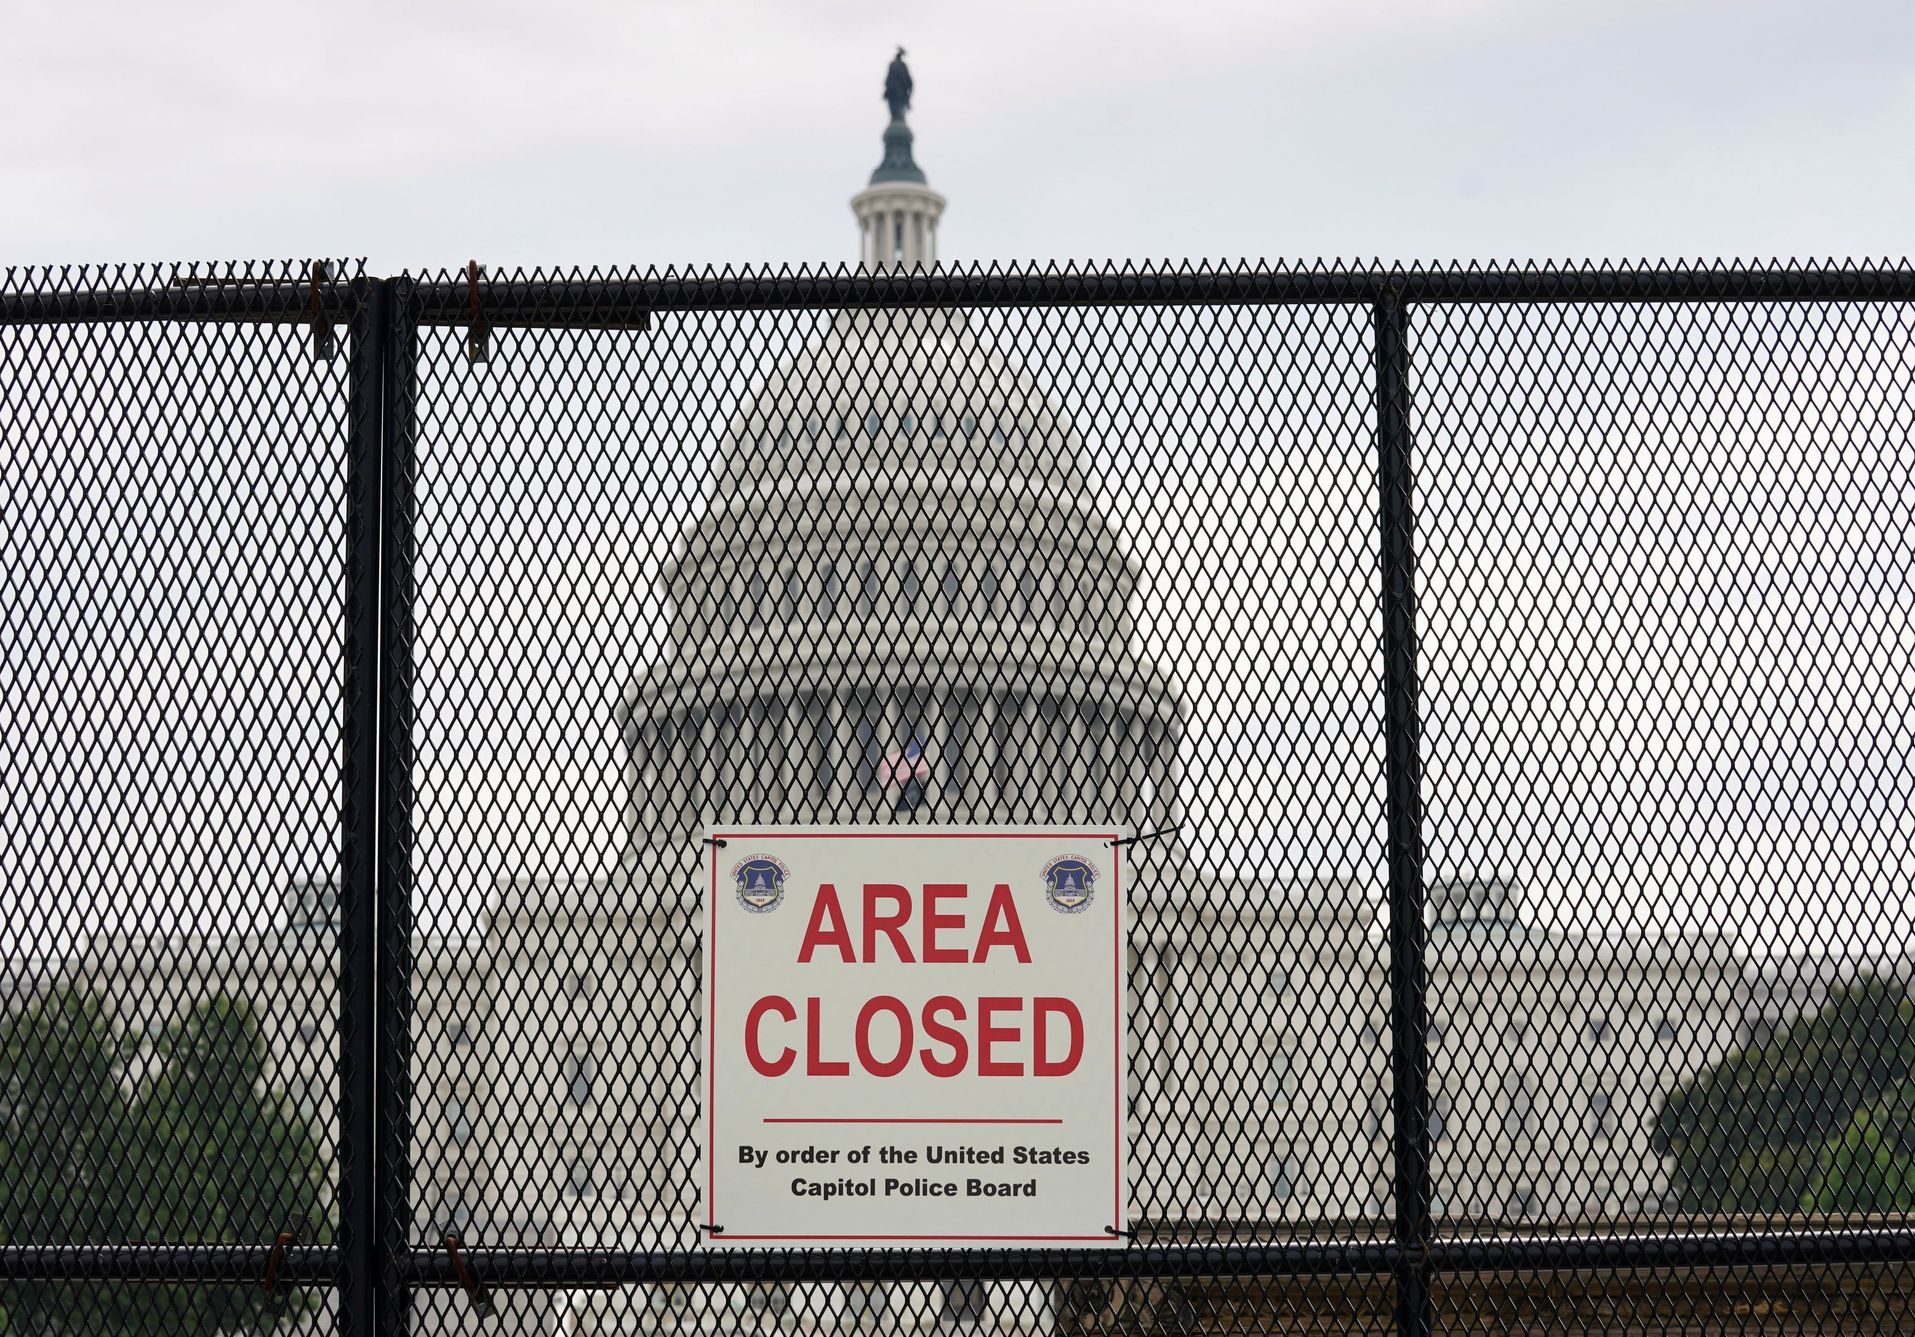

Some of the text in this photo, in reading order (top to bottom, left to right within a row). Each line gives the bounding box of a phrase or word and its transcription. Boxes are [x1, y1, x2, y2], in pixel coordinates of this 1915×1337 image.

[744, 855, 759, 863] STATES
[1053, 855, 1069, 863] STATES
[797, 883, 1032, 964] AREA
[744, 995, 1085, 1079] CLOSED
[738, 1145, 1090, 1169] By order of the United States
[790, 1177, 1037, 1201] Capitol Police Board
